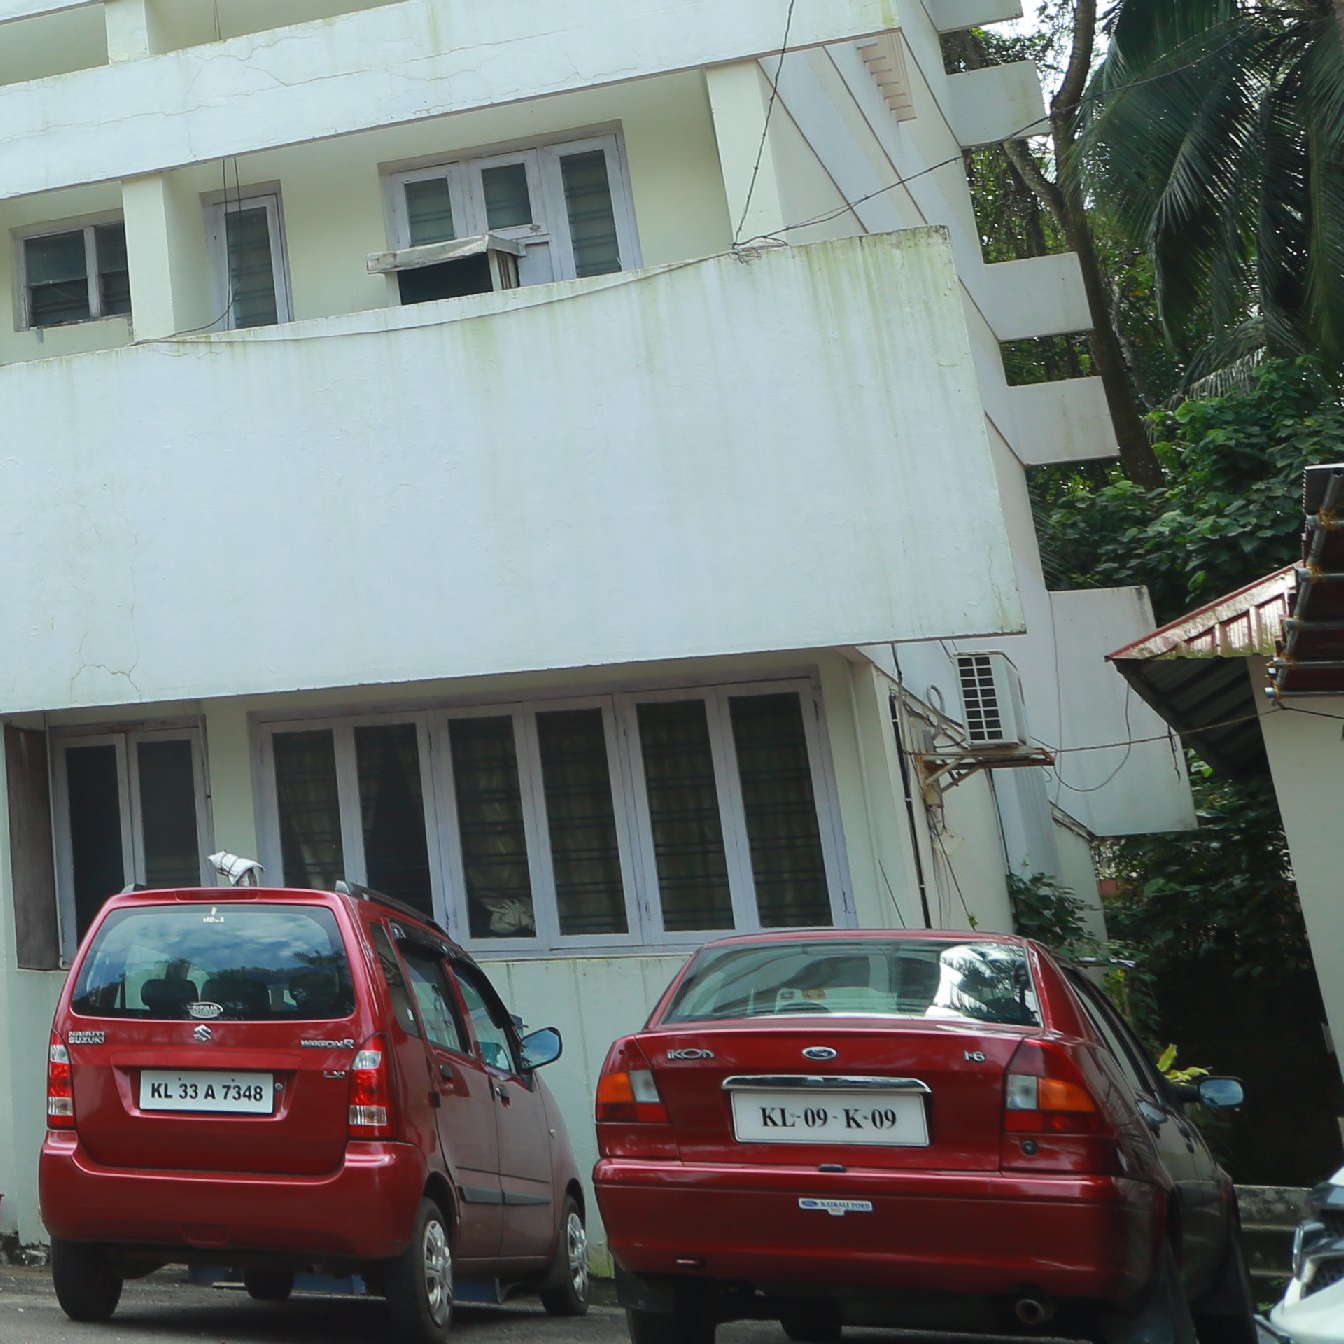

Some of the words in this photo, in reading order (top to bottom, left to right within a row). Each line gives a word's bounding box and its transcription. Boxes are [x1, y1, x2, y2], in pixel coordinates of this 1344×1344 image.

[150, 1082, 173, 1099] KL
[178, 1083, 199, 1099] 33
[203, 1084, 217, 1100] A
[221, 1084, 264, 1102] 7348
